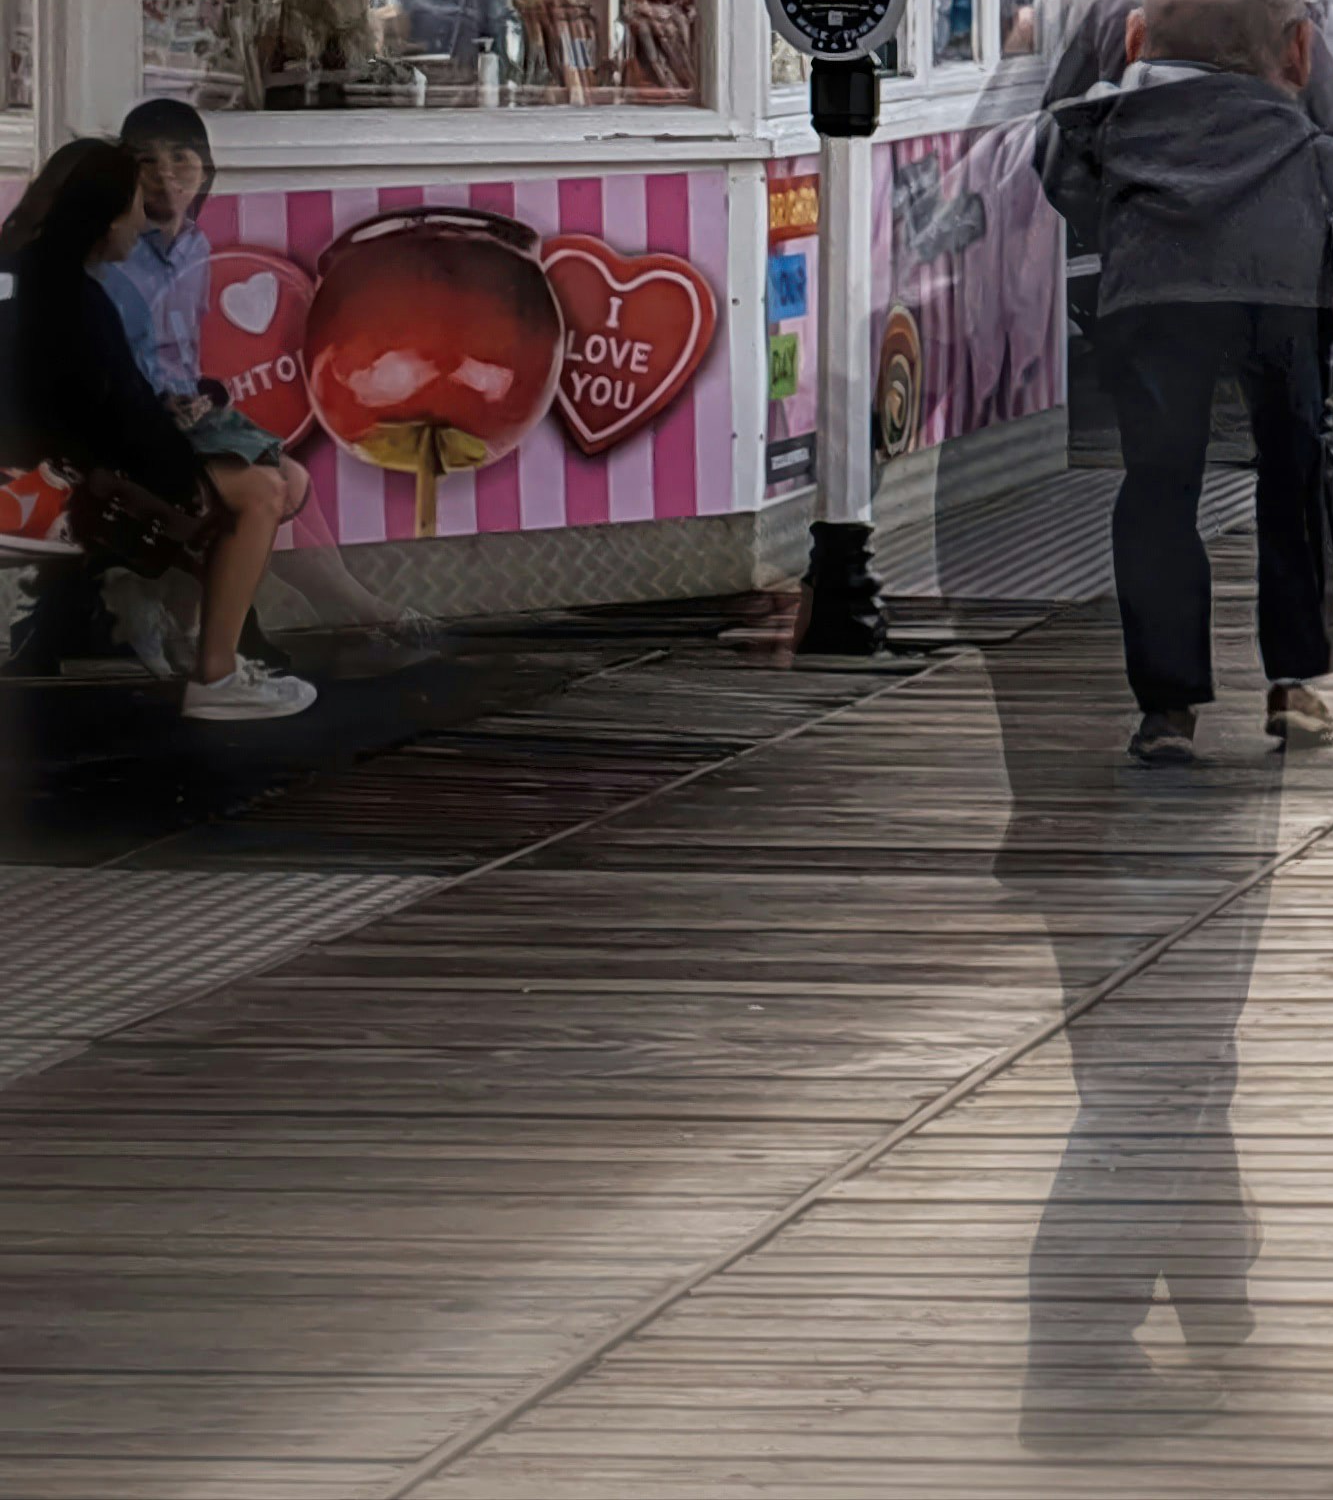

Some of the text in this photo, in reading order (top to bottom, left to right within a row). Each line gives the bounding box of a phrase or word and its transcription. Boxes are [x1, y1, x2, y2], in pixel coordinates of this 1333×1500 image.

[605, 296, 623, 328] I
[567, 328, 653, 374] LOVE
[569, 369, 637, 411] YOU
